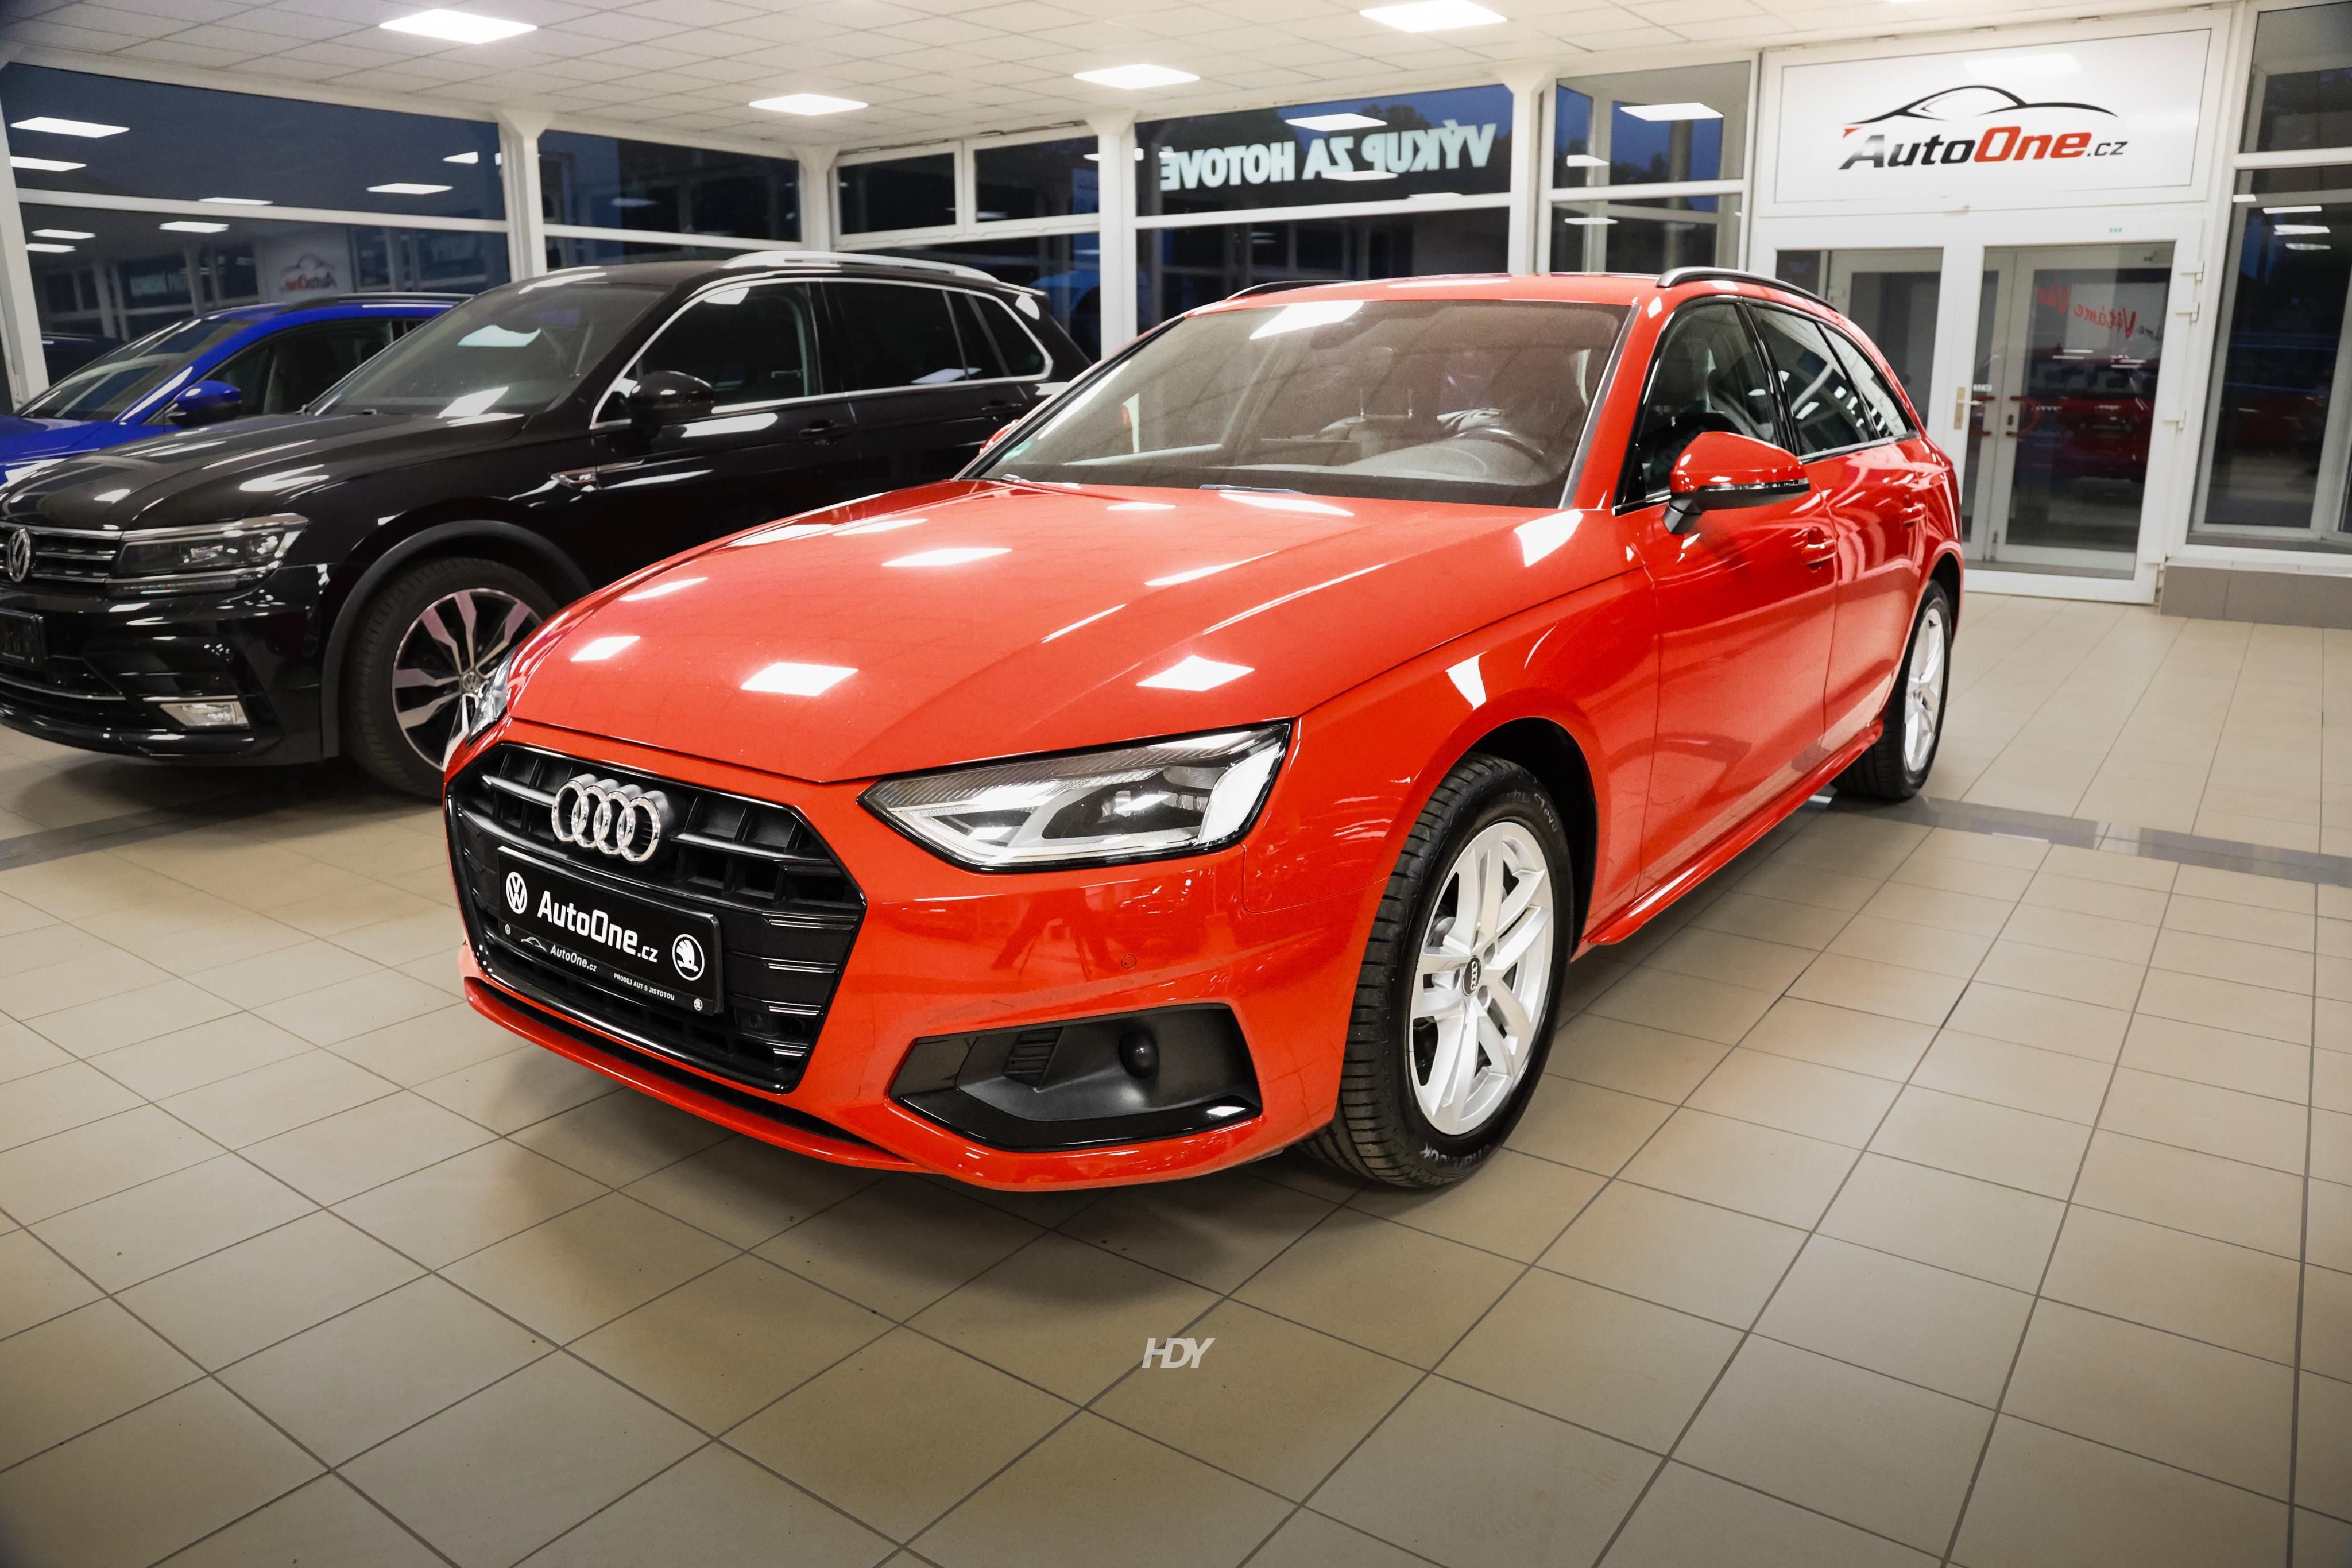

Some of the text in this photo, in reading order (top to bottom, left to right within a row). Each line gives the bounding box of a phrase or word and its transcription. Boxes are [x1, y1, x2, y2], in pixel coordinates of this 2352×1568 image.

[1839, 126, 2129, 171] AutoOne.cz
[537, 890, 658, 963] AutoOne.cz
[550, 944, 597, 973] AutoOne.cz
[613, 973, 632, 985] PRODEJ
[633, 981, 644, 989] AUT
[649, 987, 675, 1000] JISTOTOU
